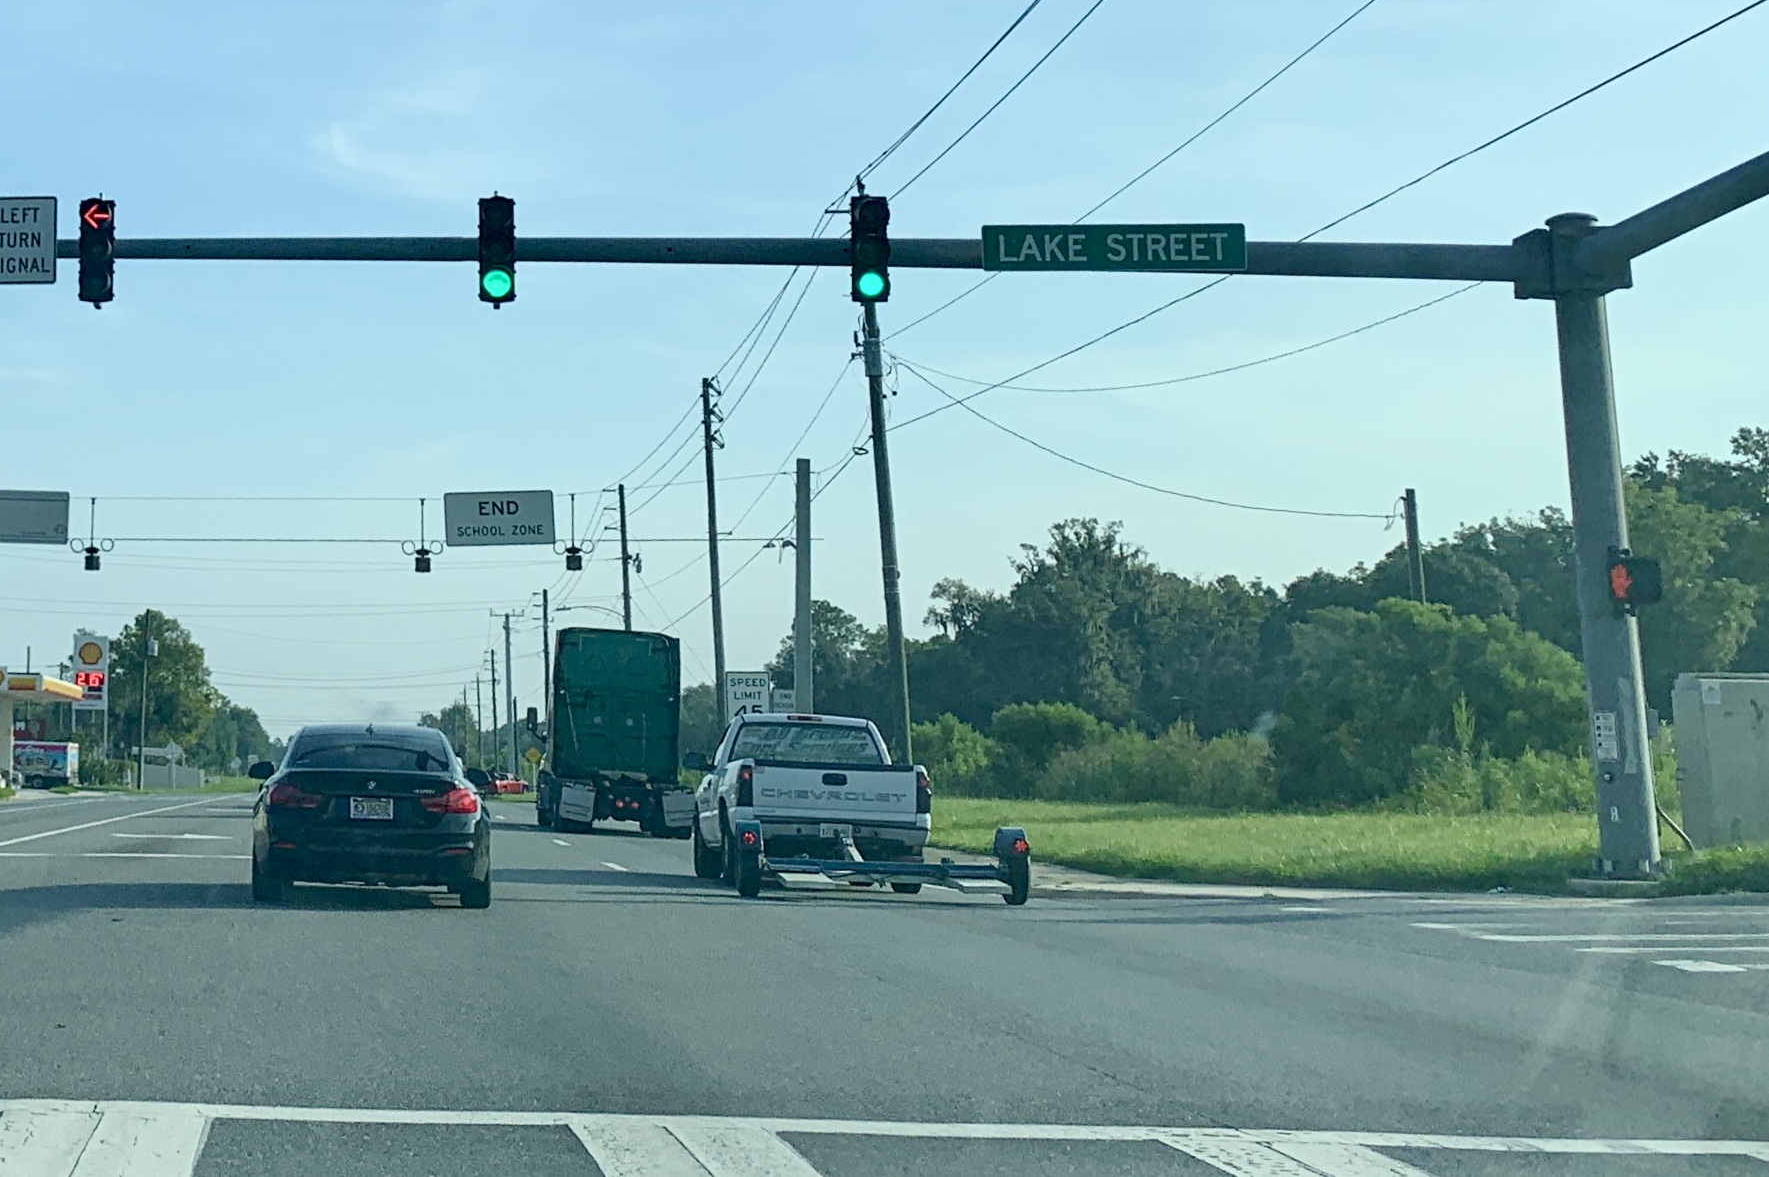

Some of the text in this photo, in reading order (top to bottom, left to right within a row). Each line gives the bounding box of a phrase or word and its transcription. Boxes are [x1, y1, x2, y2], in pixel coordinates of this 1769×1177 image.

[0, 207, 40, 224] LEFT
[998, 232, 1228, 262] LAKE STREET
[478, 500, 519, 516] END
[457, 524, 544, 537] SCHOOL ZONE
[730, 678, 766, 687] SPEED
[734, 691, 761, 700] LIMIT
[761, 788, 906, 803] CHEVROLET
